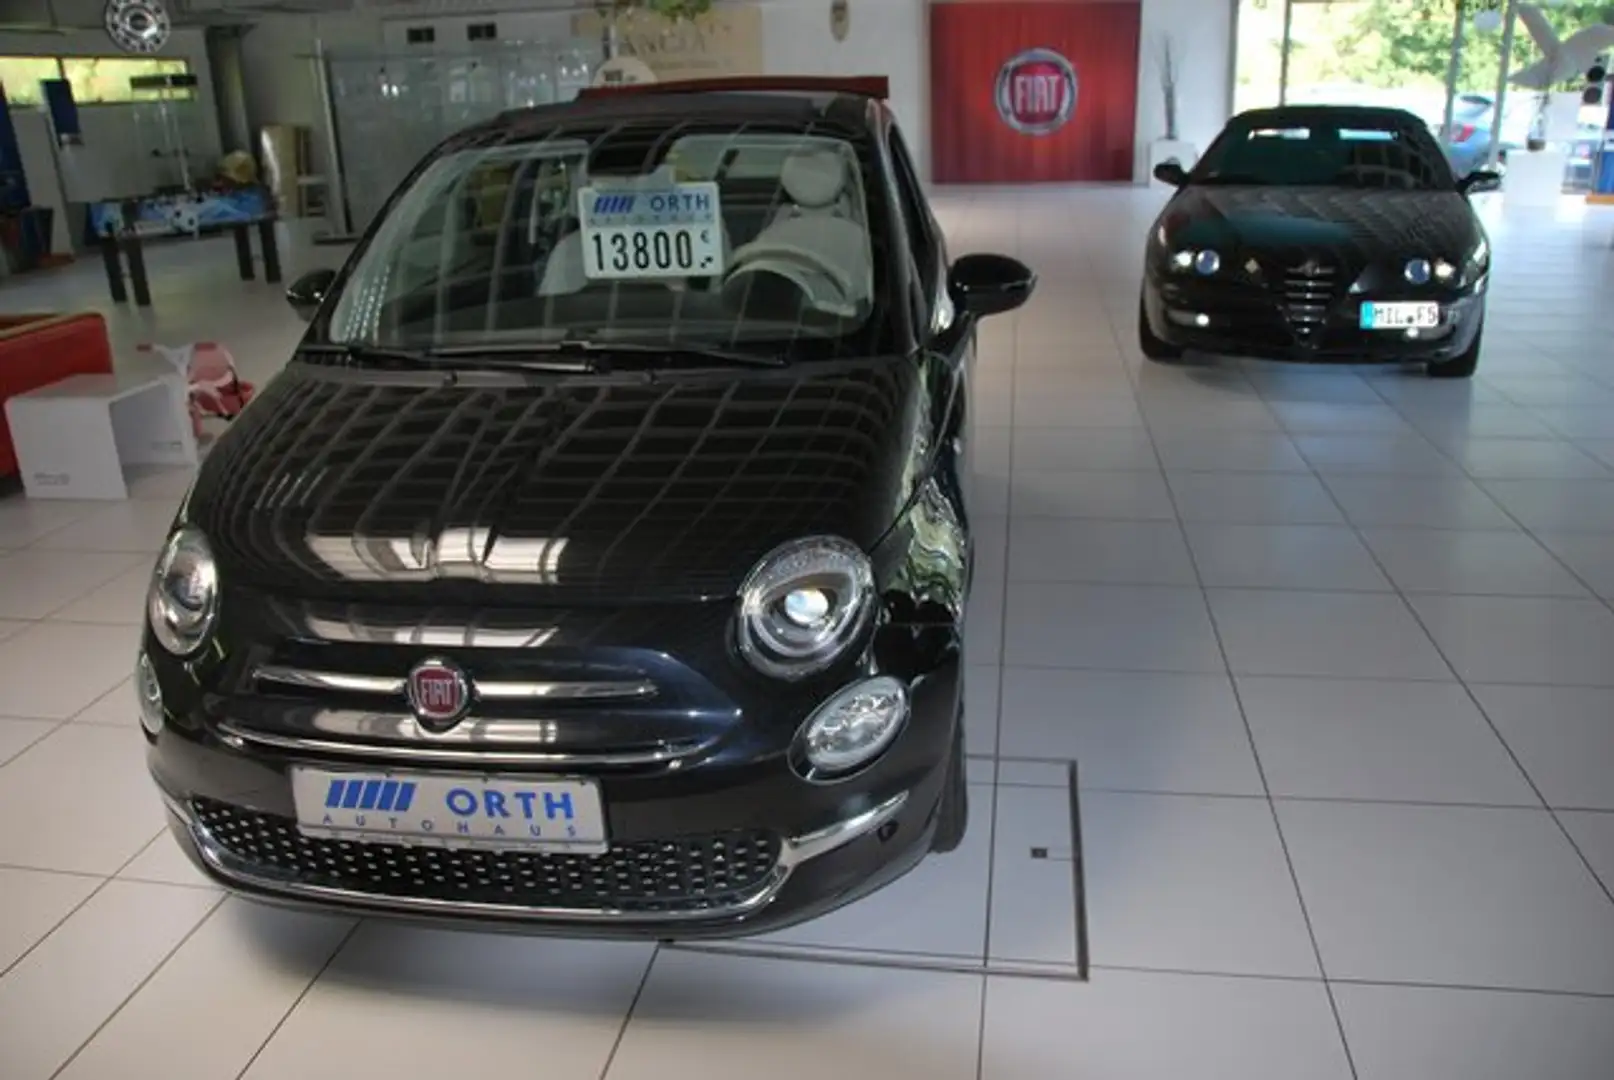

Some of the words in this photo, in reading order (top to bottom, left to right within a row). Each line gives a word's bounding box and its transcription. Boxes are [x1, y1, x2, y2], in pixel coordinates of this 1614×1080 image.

[1015, 75, 1060, 114] FIAT
[650, 192, 710, 212] ORTH
[592, 228, 693, 271] 13800
[421, 679, 452, 705] FIAT
[446, 787, 575, 820] ORTH
[322, 812, 577, 838] AUTOHAUS
